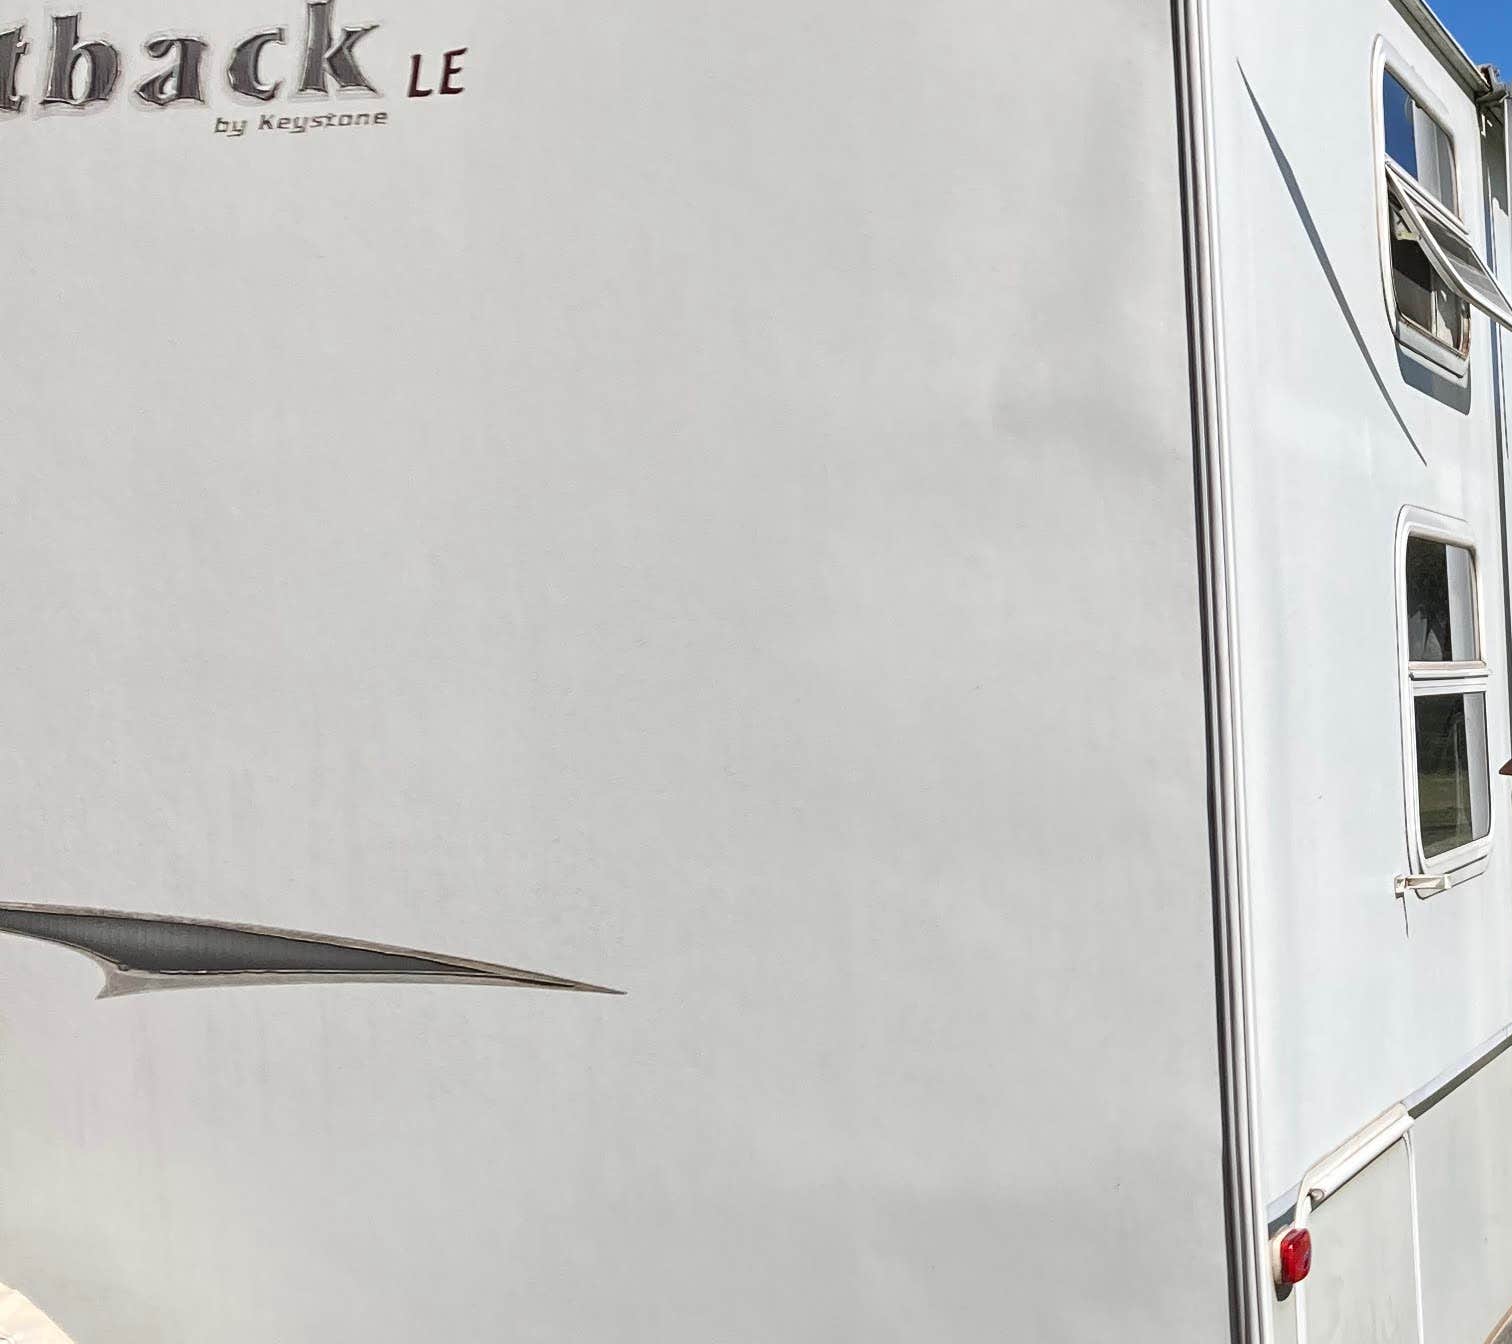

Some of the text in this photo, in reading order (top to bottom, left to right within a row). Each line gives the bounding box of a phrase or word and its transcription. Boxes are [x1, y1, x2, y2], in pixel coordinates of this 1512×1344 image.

[407, 47, 468, 98] LE
[214, 111, 388, 137] by Keystone
